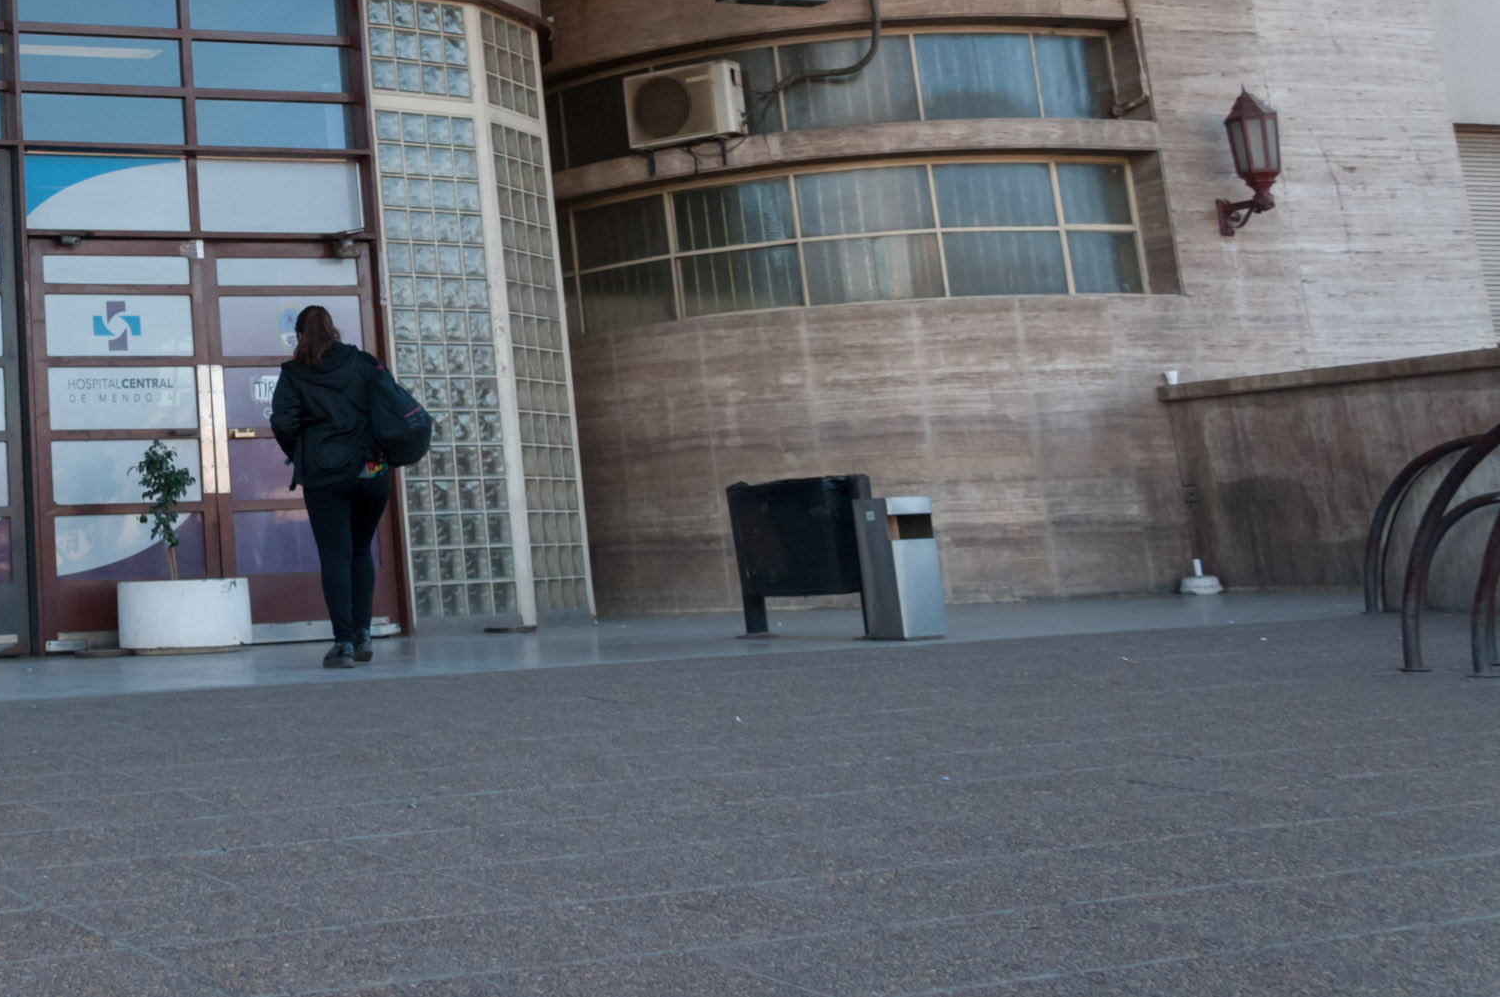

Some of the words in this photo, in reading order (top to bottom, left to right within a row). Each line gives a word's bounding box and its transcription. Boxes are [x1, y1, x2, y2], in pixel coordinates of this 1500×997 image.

[254, 379, 276, 398] TIR
[68, 394, 88, 404] DE
[98, 392, 174, 404] MENDOZA
